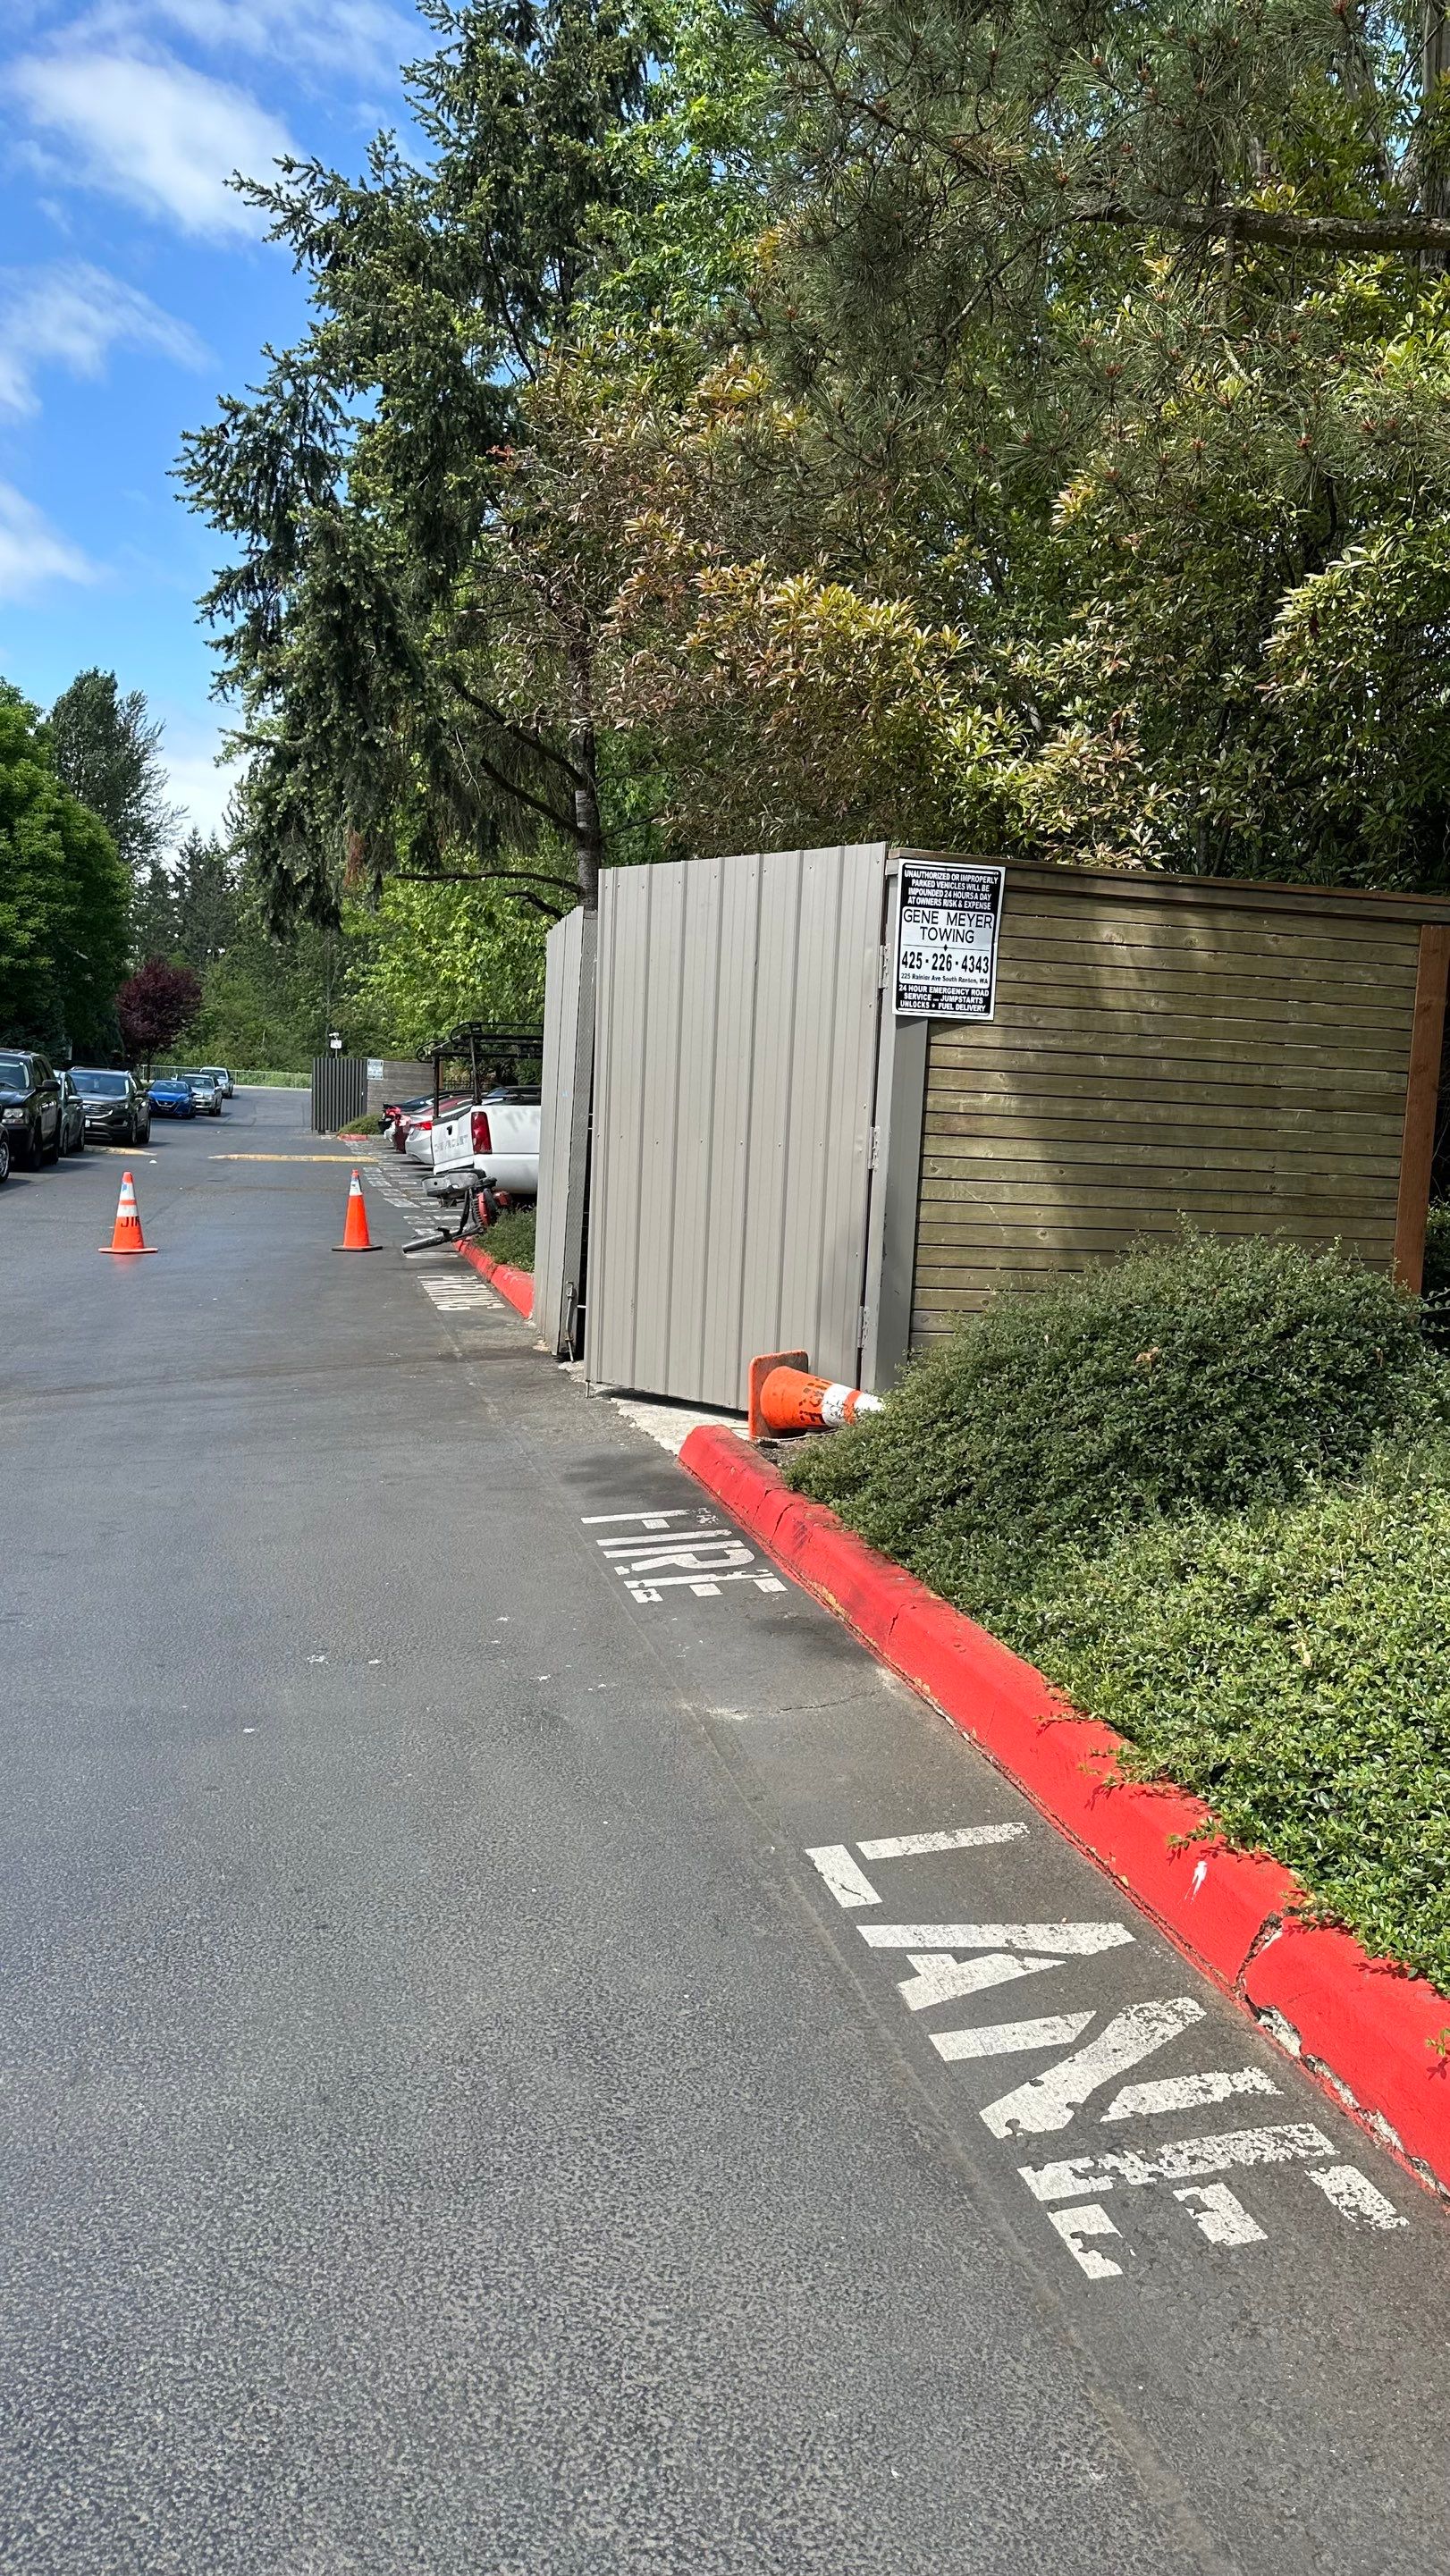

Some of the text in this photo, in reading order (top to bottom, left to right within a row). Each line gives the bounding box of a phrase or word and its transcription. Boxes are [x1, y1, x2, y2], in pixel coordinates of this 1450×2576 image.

[904, 869, 950, 880] UNAUTHORIZED
[960, 874, 999, 884] IMPROPERLY
[912, 879, 990, 892] PARKED VEHICLES WILL BE
[908, 887, 943, 897] IMPOUNDED
[944, 890, 952, 898] 24
[953, 891, 974, 900] HOURS
[980, 893, 991, 901] DAY
[907, 896, 991, 910] AT OWNERS RISK & EXPENSE
[904, 909, 992, 929] GENE MEYER
[920, 926, 974, 943] TOWING
[901, 951, 989, 973] 425 226 4343
[904, 992, 932, 1001] SERVICE
[940, 995, 983, 1004] JUMPSTARTS
[908, 985, 928, 993] HOUR
[929, 986, 970, 996] EMERGENCY
[971, 989, 990, 997] ROAD
[900, 999, 986, 1012] UNLOCKS FUEL DELIVERY
[417, 1275, 506, 1311] PARKING
[581, 1508, 788, 1604] FIRE
[805, 1822, 1409, 2280] LANE
